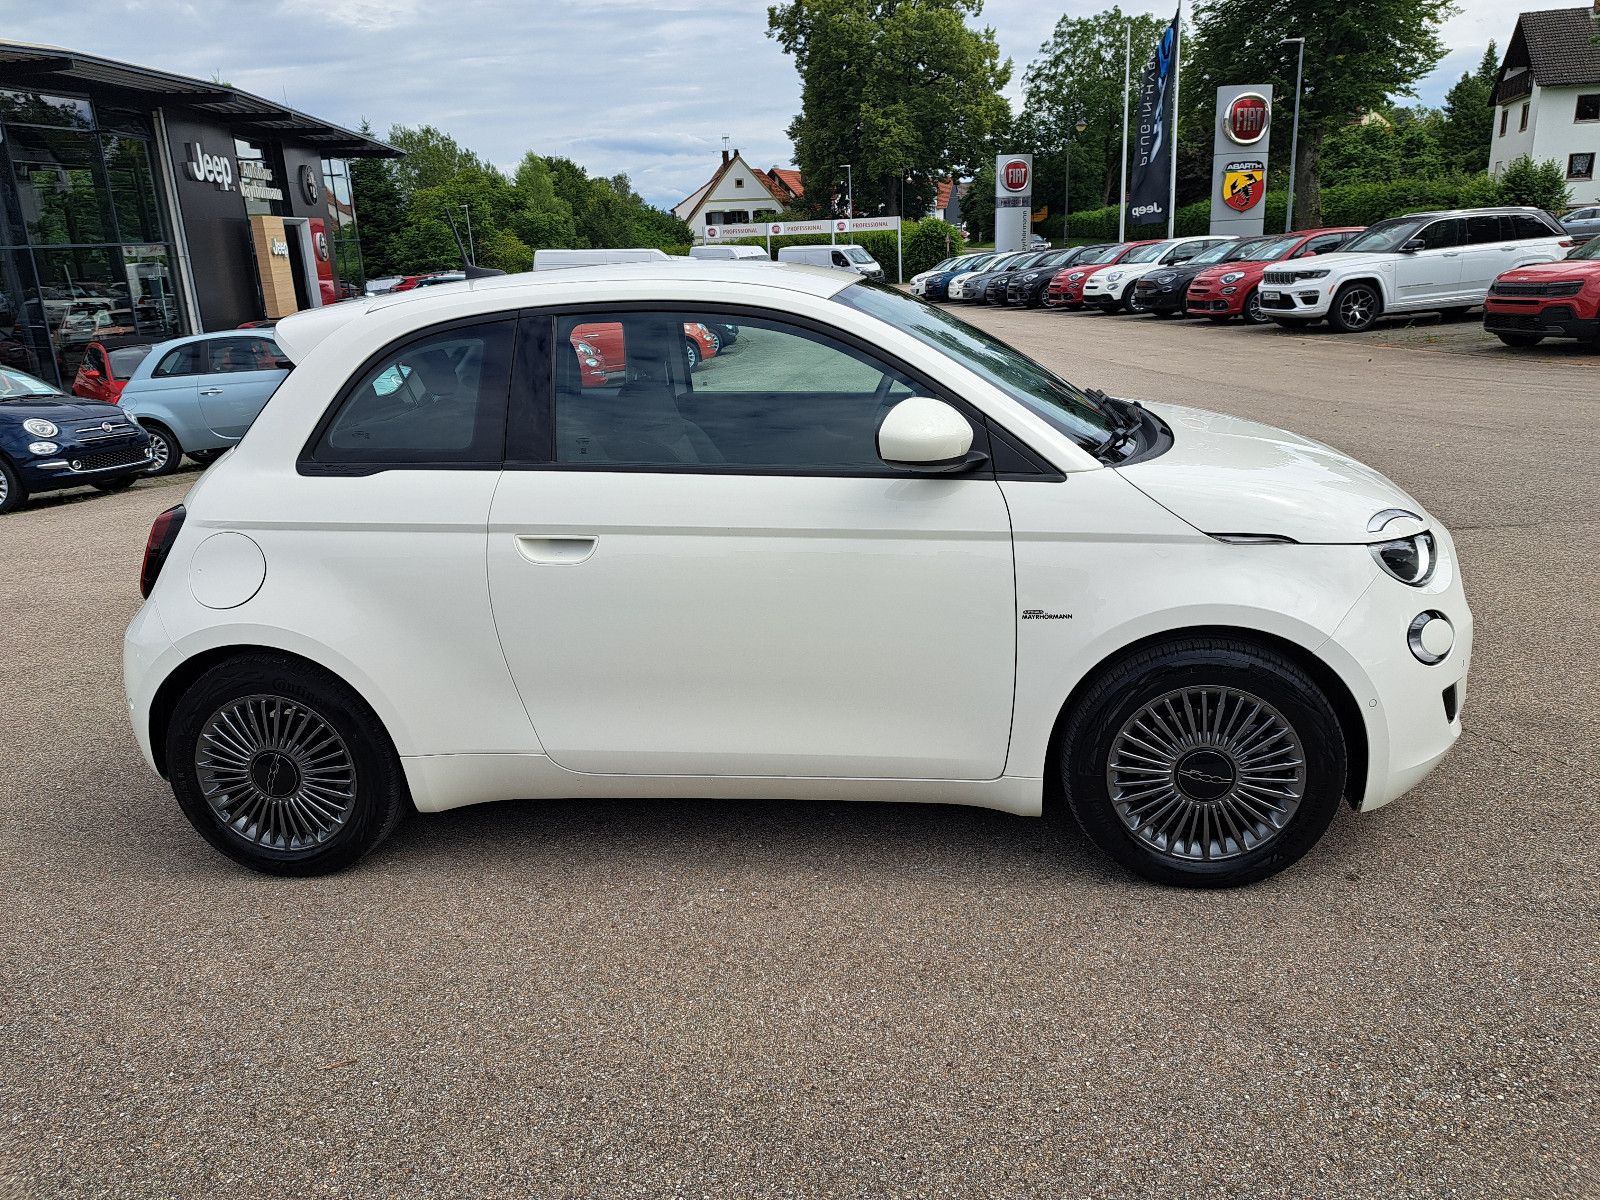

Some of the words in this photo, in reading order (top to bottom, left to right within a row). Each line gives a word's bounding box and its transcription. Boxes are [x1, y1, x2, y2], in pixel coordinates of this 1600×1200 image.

[1236, 107, 1264, 131] FIAT
[193, 142, 233, 191] Jeep
[1227, 162, 1262, 170] ABARTH
[1008, 168, 1026, 183] FIAT
[787, 224, 823, 232] PROFESSIONAL
[852, 221, 889, 229] PROFESSIONAL
[272, 237, 288, 258] Jeep
[1022, 612, 1073, 620] MAYRHÖRMANN
